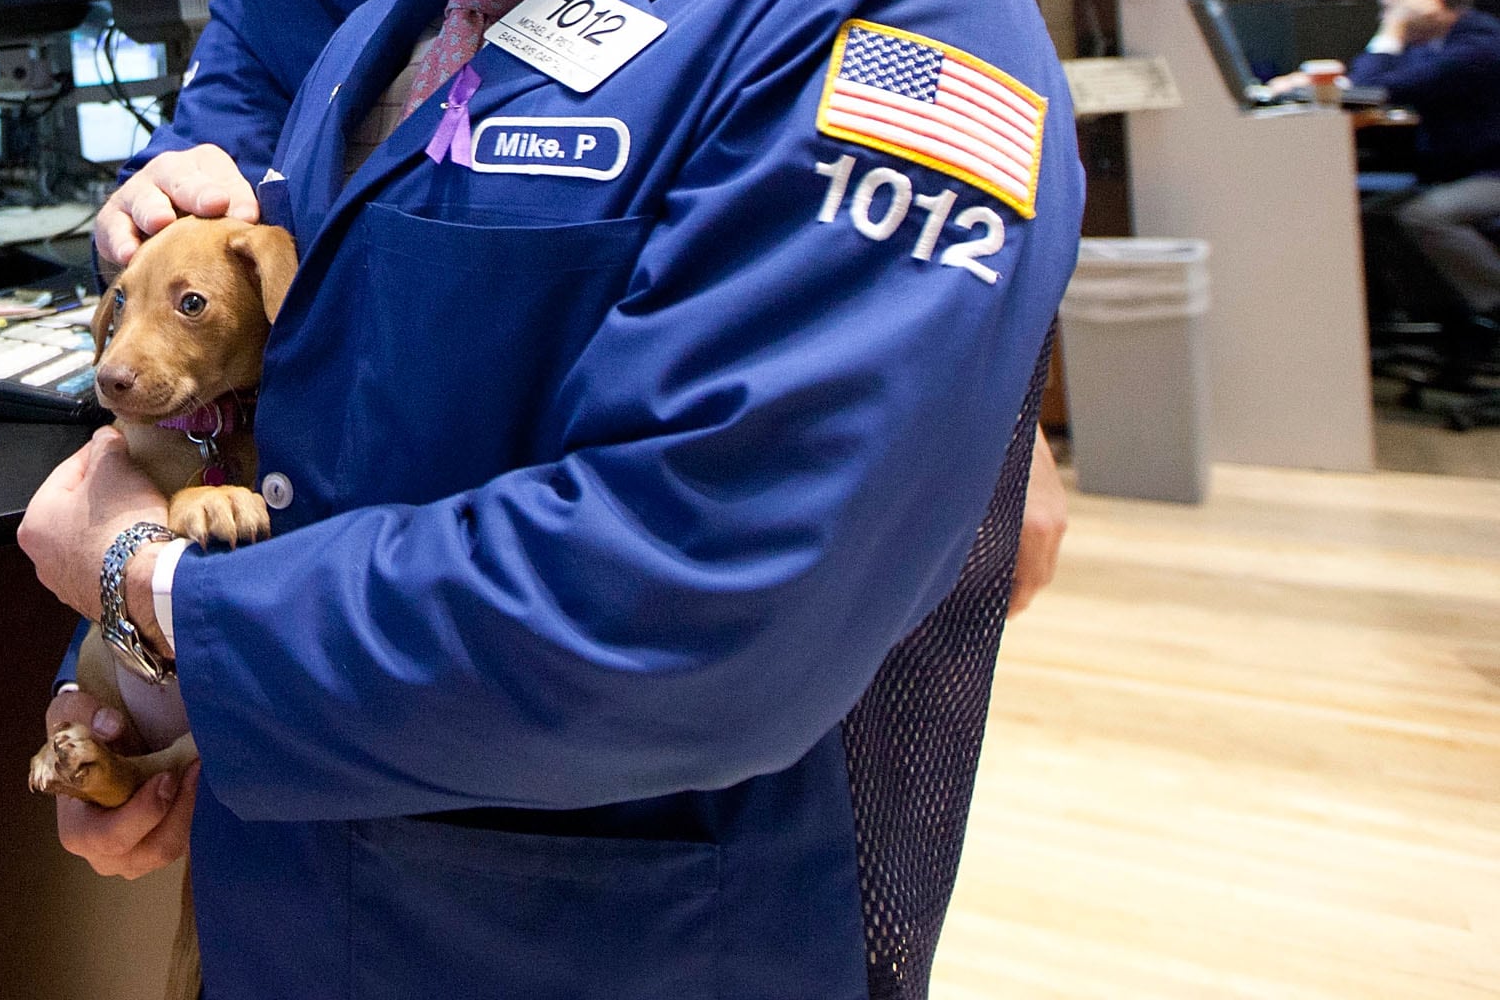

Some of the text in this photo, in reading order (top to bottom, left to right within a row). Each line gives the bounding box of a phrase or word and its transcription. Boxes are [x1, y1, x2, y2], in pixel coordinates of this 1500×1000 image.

[494, 132, 597, 160] Mike. P
[815, 154, 1002, 285] 1012
